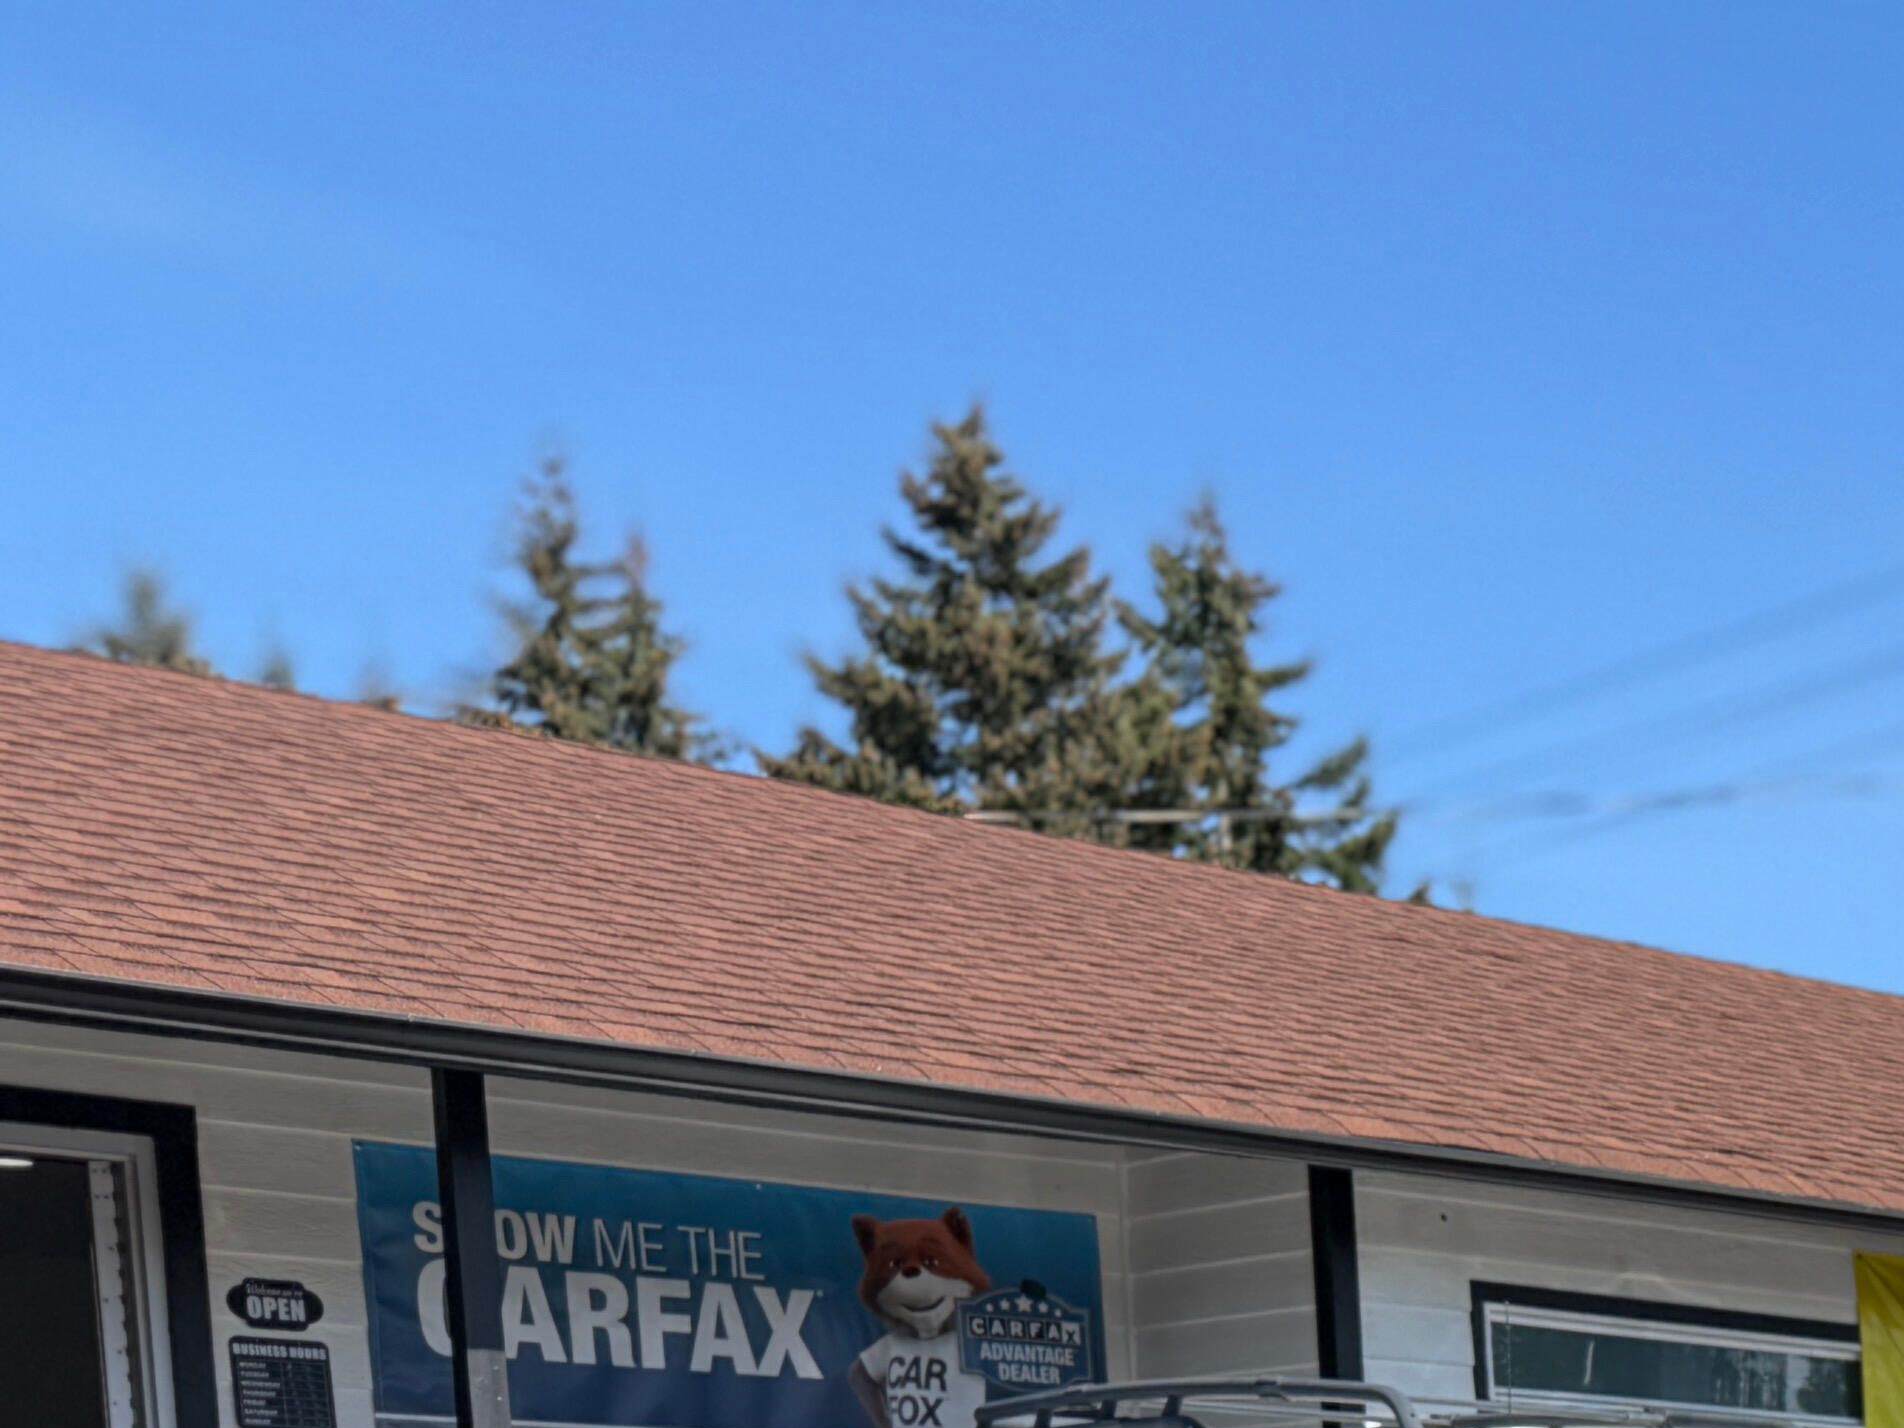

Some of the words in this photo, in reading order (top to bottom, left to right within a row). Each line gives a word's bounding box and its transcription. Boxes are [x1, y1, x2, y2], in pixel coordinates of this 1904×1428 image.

[412, 1201, 577, 1264] SOW
[593, 1218, 667, 1272] ME
[677, 1225, 766, 1280] THE
[246, 1295, 306, 1322] OPEN
[971, 1318, 1079, 1345] CARFAX
[232, 1342, 288, 1359] BUSINESS
[289, 1347, 327, 1361] HOURS
[980, 1342, 1075, 1366] ADVANTAGE
[888, 1355, 947, 1392] CAR
[998, 1363, 1061, 1385] DEALER
